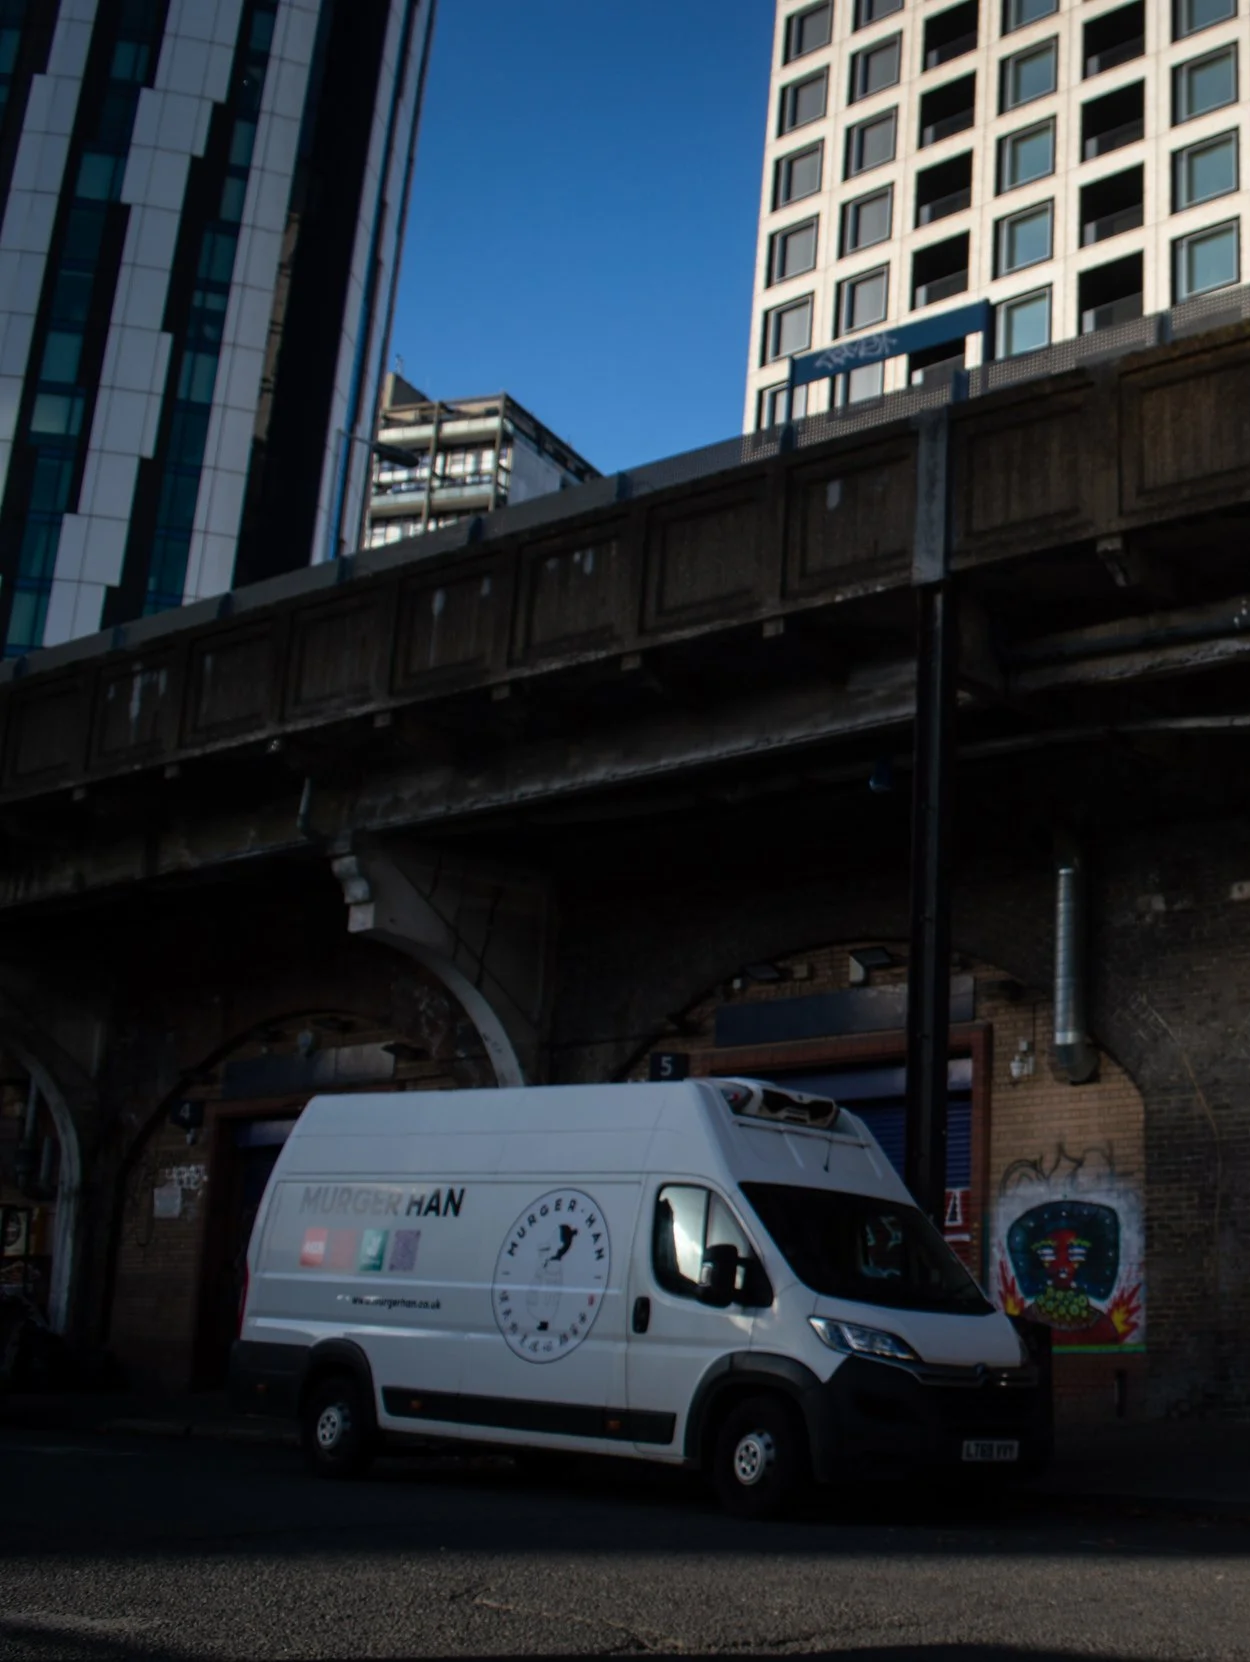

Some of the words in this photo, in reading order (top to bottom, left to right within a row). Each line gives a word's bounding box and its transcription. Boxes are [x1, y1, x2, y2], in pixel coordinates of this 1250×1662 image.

[660, 1056, 673, 1077] 5
[299, 1186, 399, 1217] MURGER
[405, 1187, 465, 1217] HAN
[507, 1198, 577, 1257] MURGER
[585, 1213, 604, 1261] HAN
